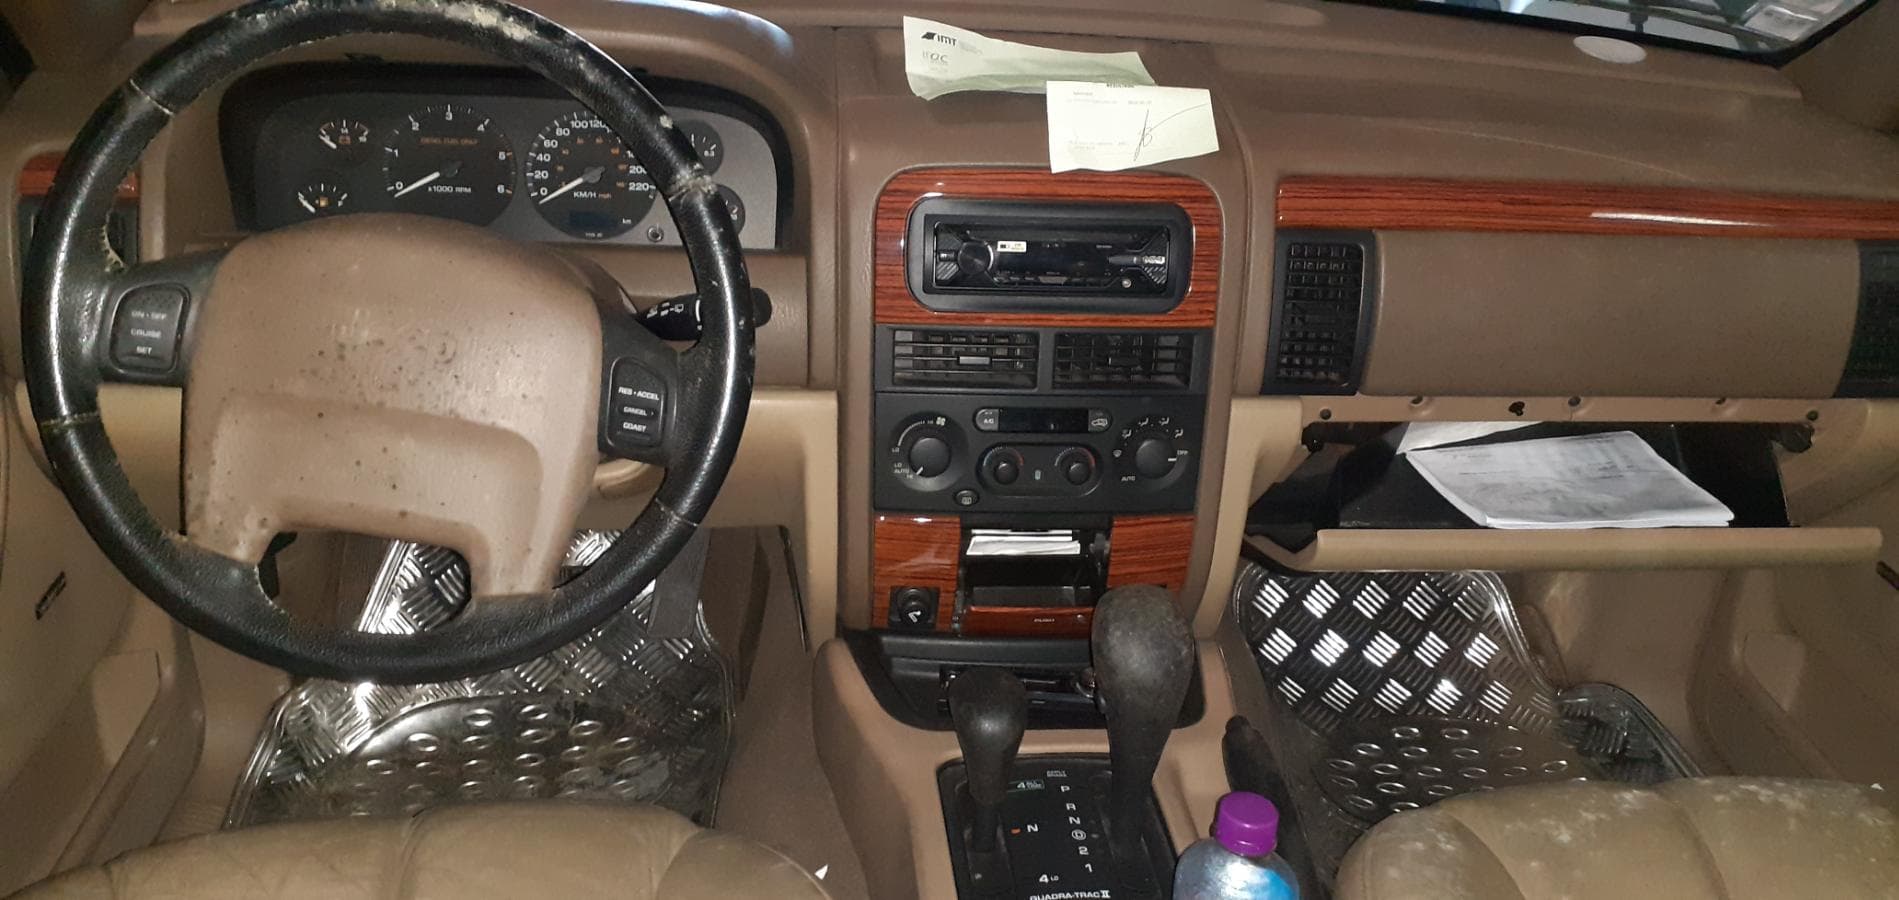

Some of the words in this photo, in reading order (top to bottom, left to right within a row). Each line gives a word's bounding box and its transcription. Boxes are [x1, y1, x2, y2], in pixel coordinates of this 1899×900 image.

[445, 111, 453, 121] 3
[412, 121, 420, 131] 2
[477, 123, 486, 132] 4
[570, 120, 589, 129] 100
[555, 127, 570, 137] 80
[543, 140, 559, 149] 60
[536, 153, 551, 162] 40
[534, 170, 550, 180] 20
[395, 181, 404, 190] 0
[497, 184, 505, 194] 6
[628, 182, 650, 192] 220
[540, 187, 548, 196] 0
[573, 191, 597, 199] KM/H
[136, 345, 153, 355] SET
[623, 406, 648, 417] CANCEL
[623, 422, 647, 432] COAST
[1060, 785, 1071, 793] P
[1066, 803, 1076, 811] R
[1068, 816, 1081, 825] N
[1027, 823, 1039, 832] N
[1078, 846, 1089, 856] 2
[1084, 863, 1093, 873] 1
[1039, 874, 1049, 883] 4
